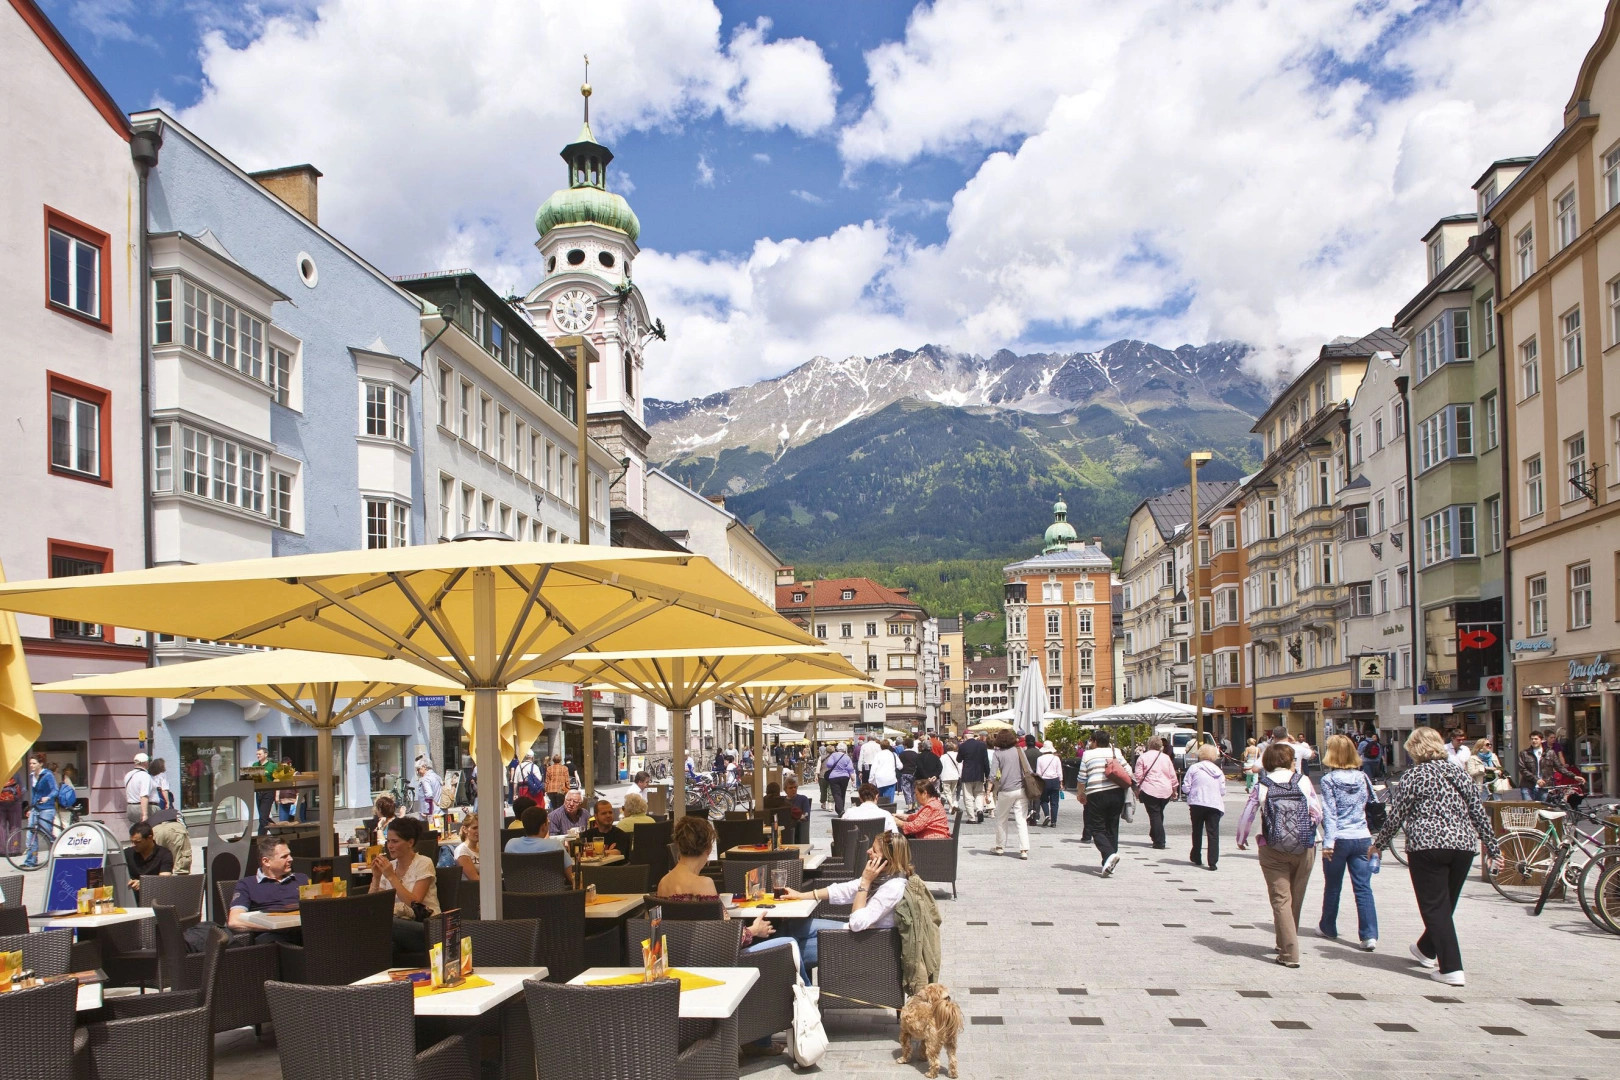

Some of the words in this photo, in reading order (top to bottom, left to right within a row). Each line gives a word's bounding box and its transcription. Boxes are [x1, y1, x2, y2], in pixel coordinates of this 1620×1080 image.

[1515, 640, 1552, 652] Douglas
[1568, 653, 1610, 683] Douglas
[67, 836, 92, 846] Zipfer
